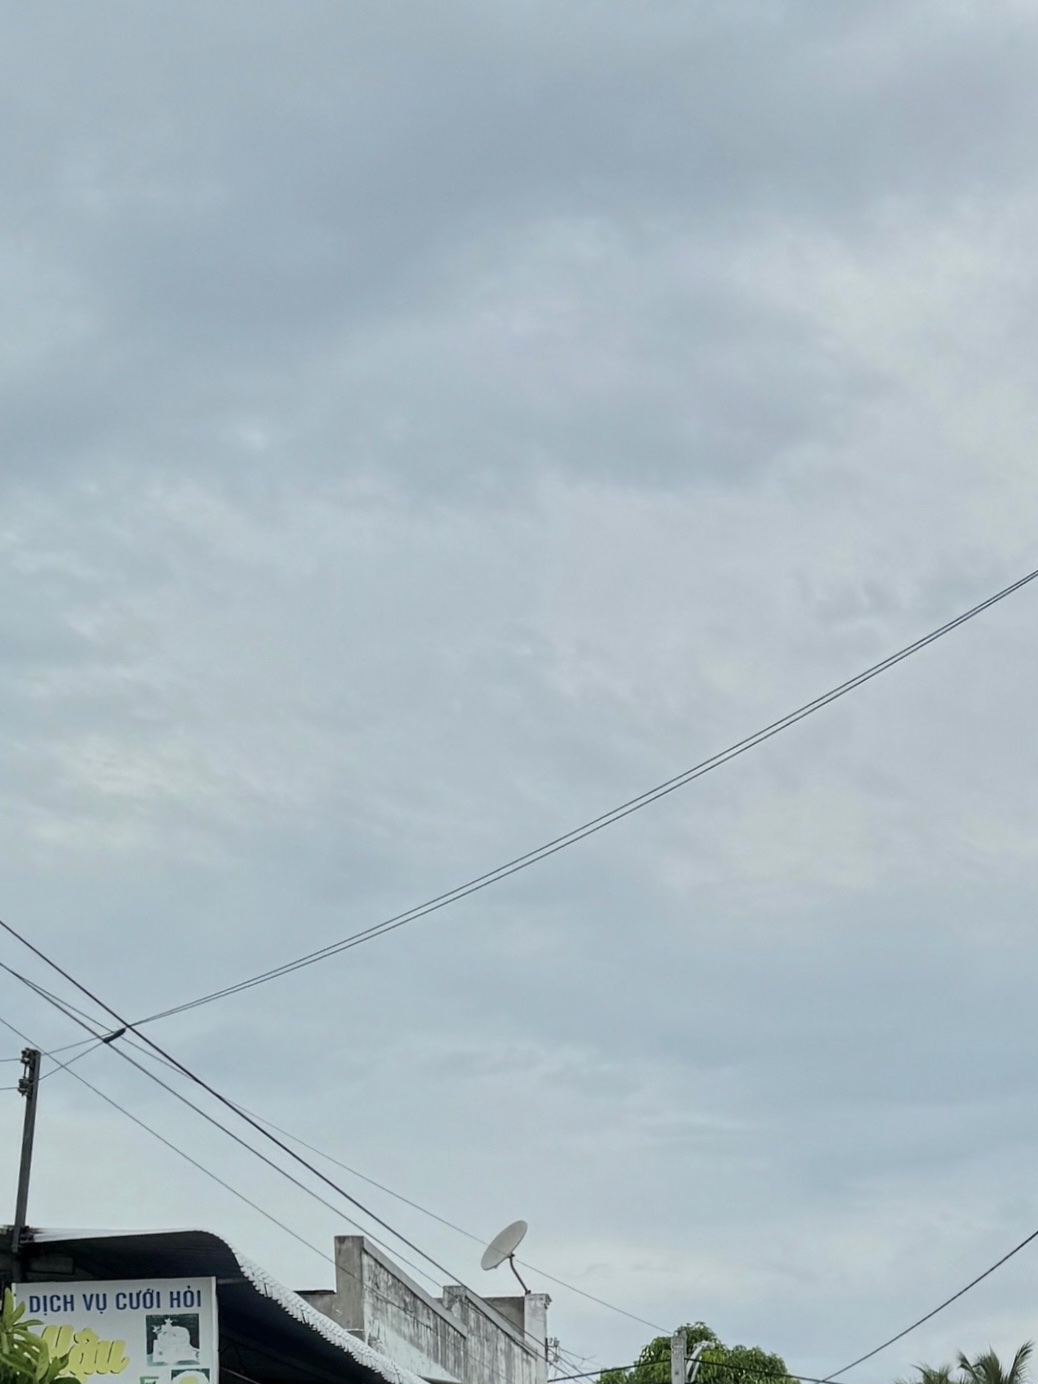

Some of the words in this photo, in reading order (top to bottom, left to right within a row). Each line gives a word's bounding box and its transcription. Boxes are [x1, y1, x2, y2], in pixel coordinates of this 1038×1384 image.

[29, 1294, 75, 1316] DỊCH
[82, 1292, 107, 1314] VỤ
[115, 1288, 160, 1310] CƯỚI
[170, 1285, 201, 1308] HỎI
